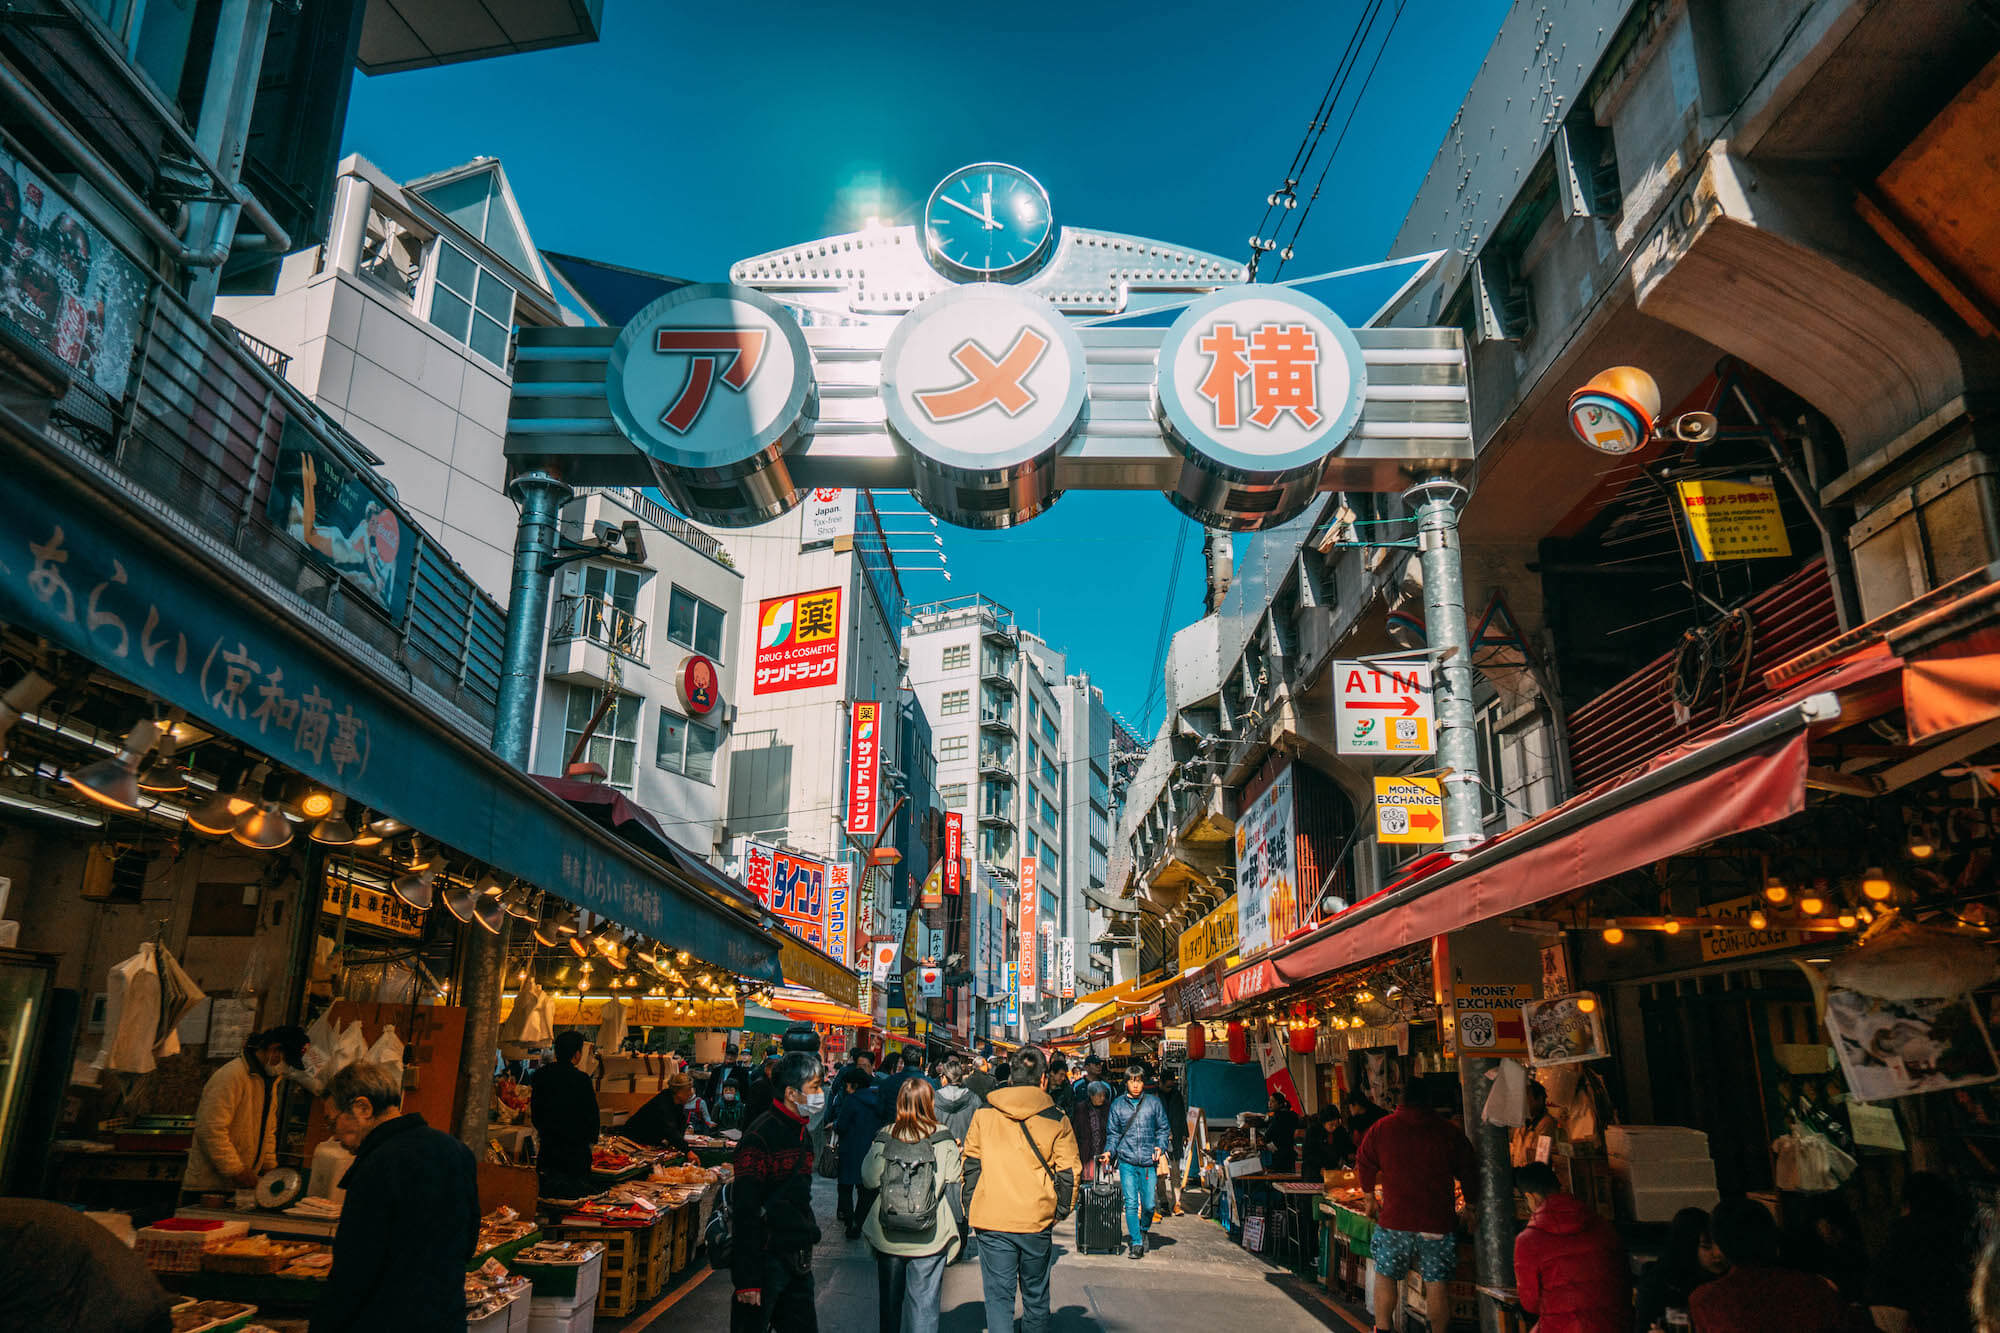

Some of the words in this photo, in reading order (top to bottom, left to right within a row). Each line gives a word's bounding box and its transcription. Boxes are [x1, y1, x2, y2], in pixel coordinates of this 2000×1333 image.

[799, 597, 833, 639] 薬
[759, 652, 783, 663] DRUG
[784, 651, 791, 660] &
[791, 643, 837, 658] COSMETIC
[756, 657, 836, 685] サンドラッグ
[1345, 670, 1421, 694] ATM
[860, 707, 873, 720] 薬
[854, 741, 872, 830] サンドラッグ
[1388, 785, 1427, 795] MONEY
[1377, 795, 1441, 805] EXCHANGE
[747, 848, 771, 907] 薬
[773, 858, 823, 918] ダイコク
[831, 865, 848, 885] 薬
[1023, 864, 1034, 916] カラオケ
[830, 889, 847, 932] ダイコク
[1470, 986, 1516, 997] MONEY
